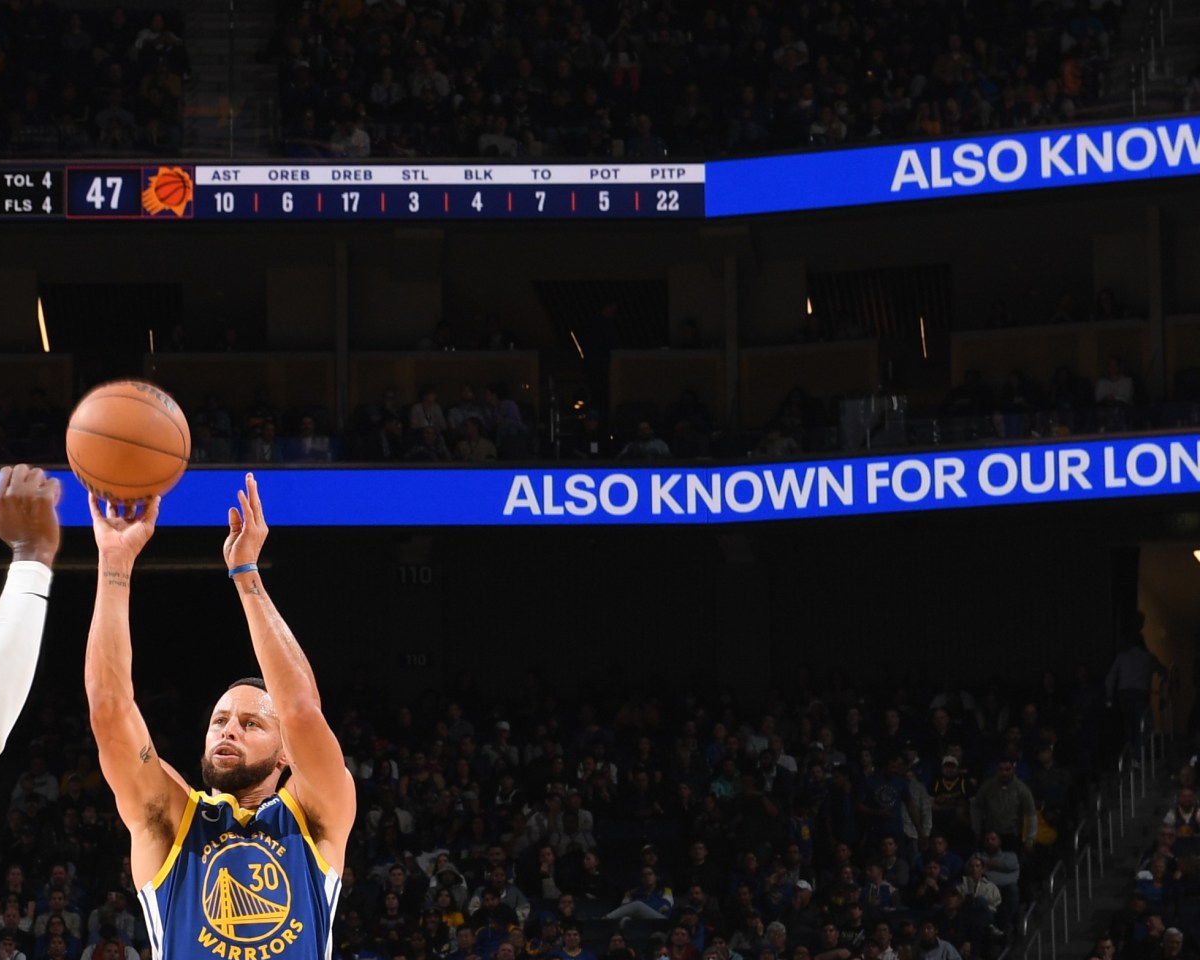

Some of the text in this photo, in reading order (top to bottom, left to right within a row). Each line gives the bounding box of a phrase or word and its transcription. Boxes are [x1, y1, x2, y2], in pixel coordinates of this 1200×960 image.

[211, 169, 686, 181] AST OREB DREB STL BLK TO POT PITP
[890, 139, 1029, 192] ALSO
[4, 171, 52, 189] TOL 4
[86, 176, 123, 210] 47
[5, 196, 52, 214] FLS 4
[214, 191, 679, 212] 10 6 17 3 4 7 5 22
[503, 440, 1200, 516] ALSO KNOWN FOR OUR LON
[248, 862, 280, 893] 30
